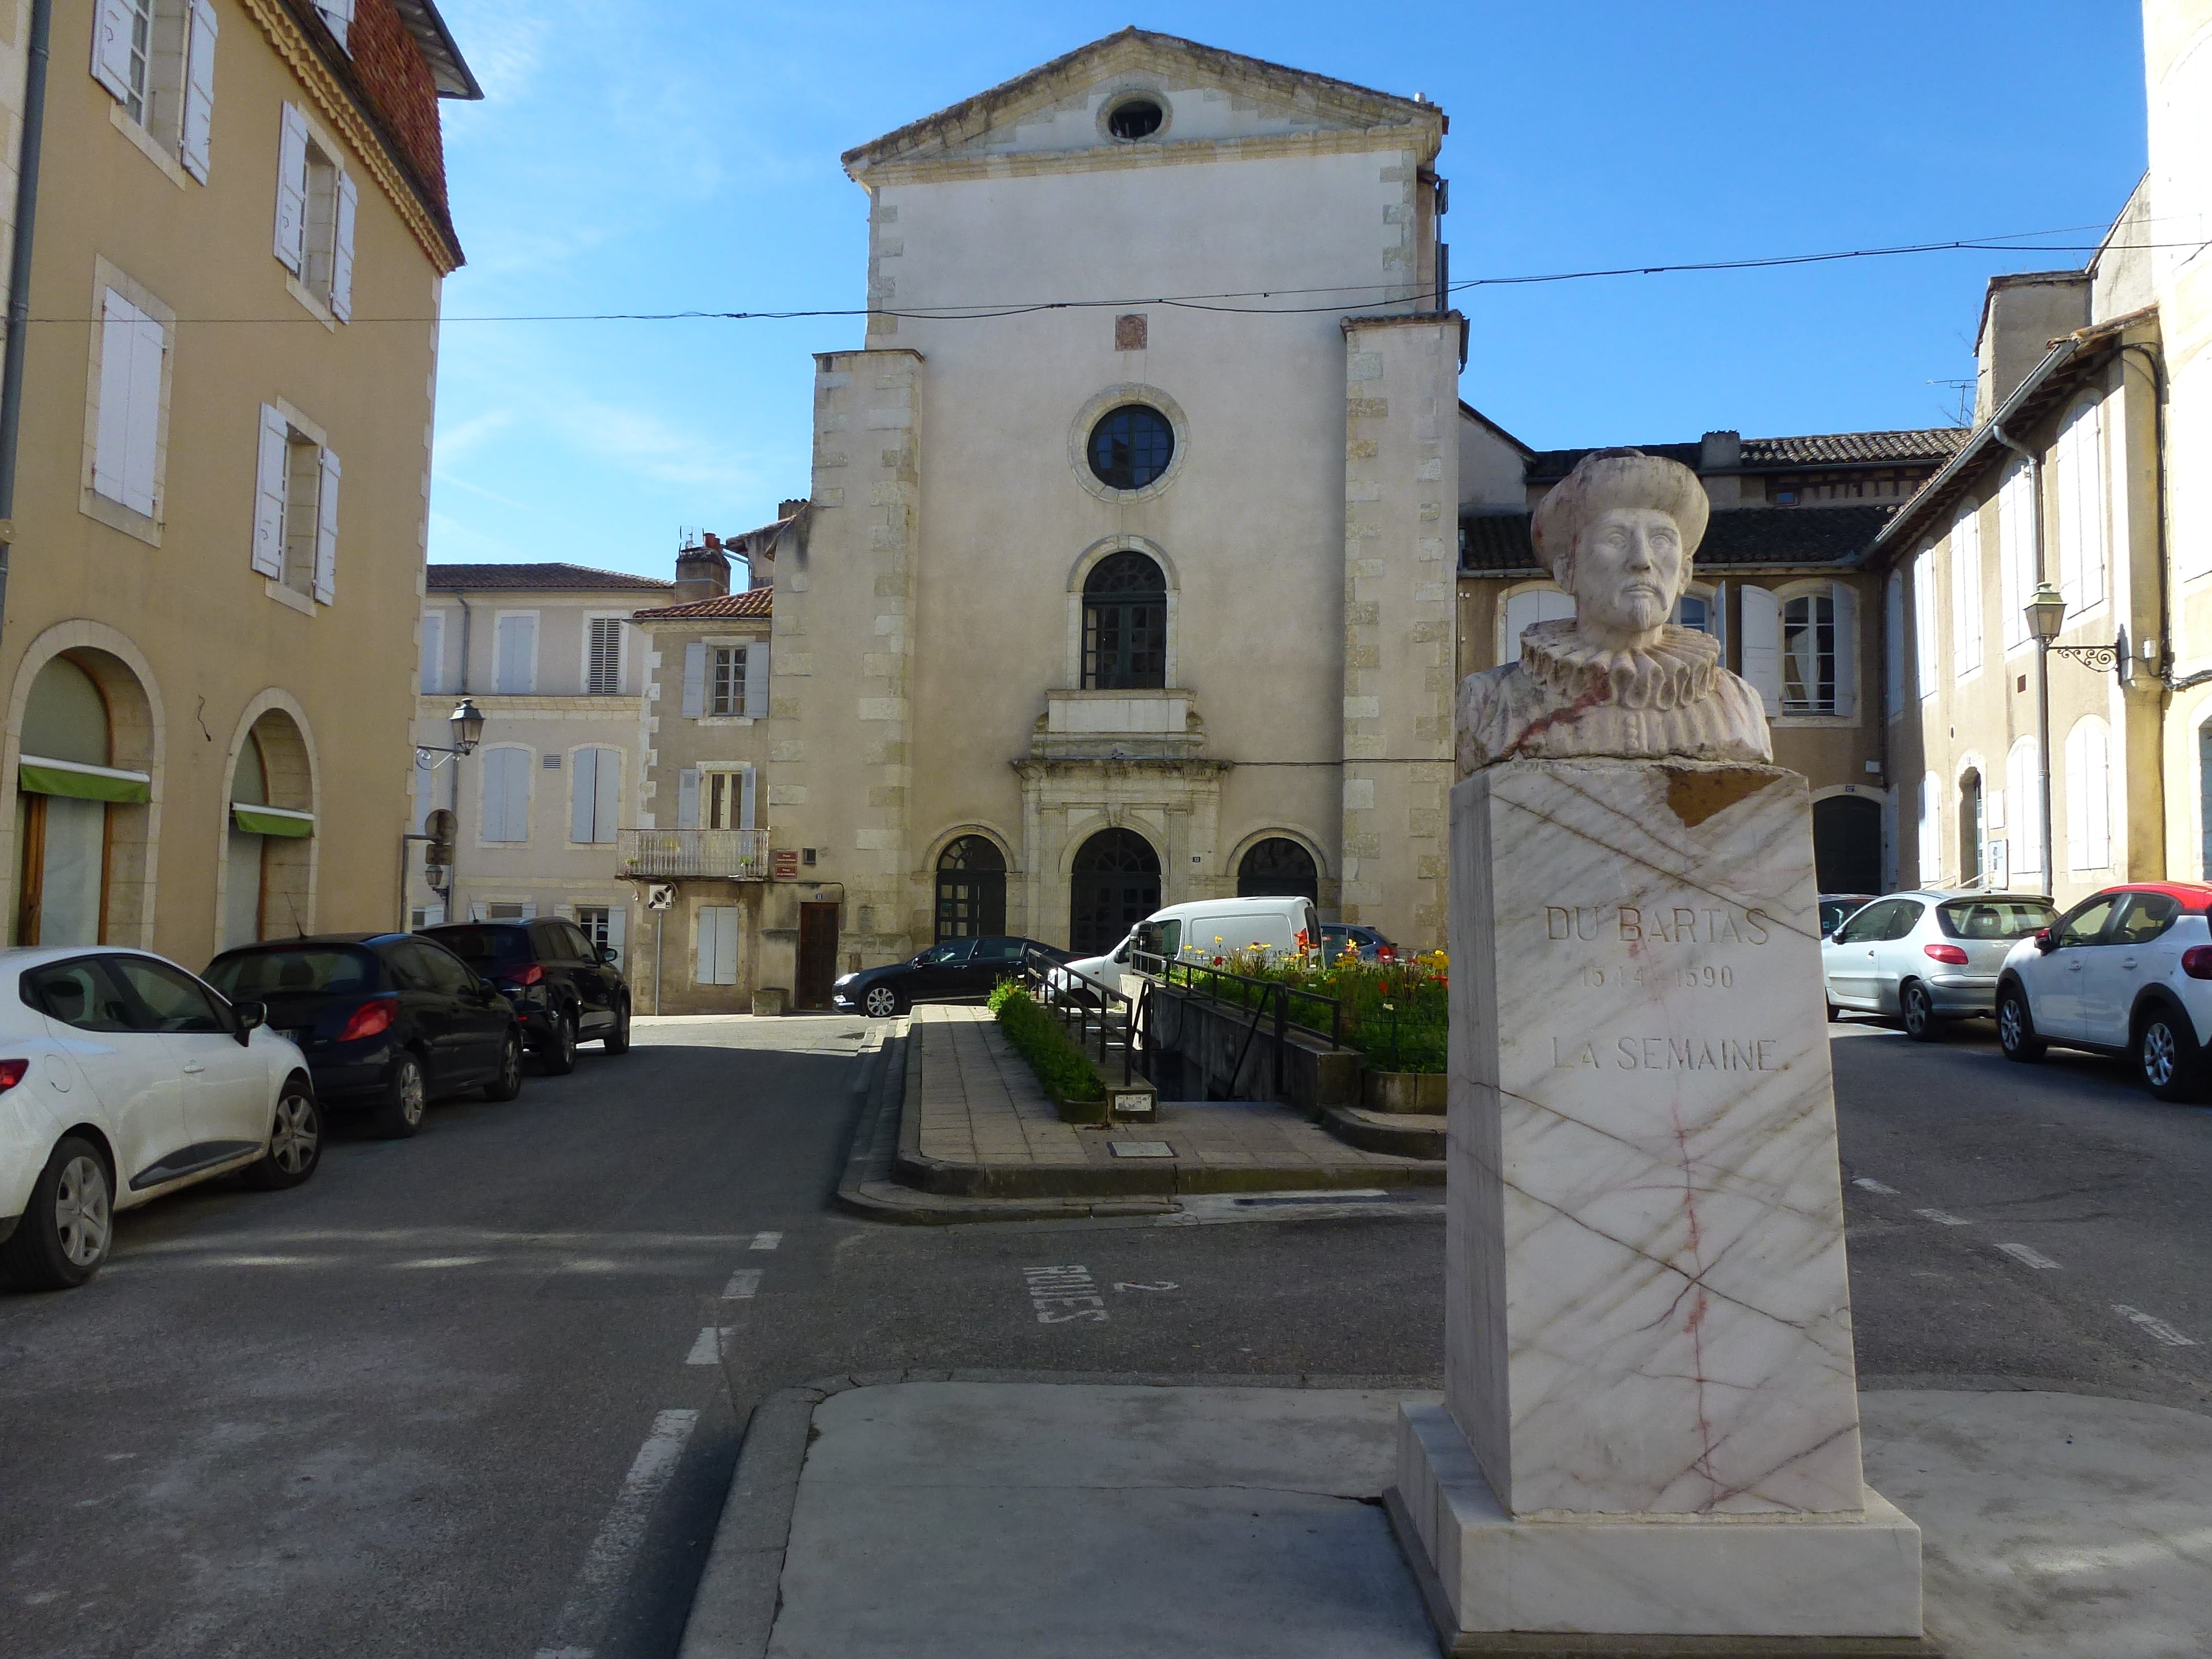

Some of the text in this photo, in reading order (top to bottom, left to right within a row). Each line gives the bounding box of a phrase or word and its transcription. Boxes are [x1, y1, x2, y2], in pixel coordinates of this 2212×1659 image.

[1545, 906, 1770, 945] DU BARTAS
[1674, 966, 1734, 988] 1590
[1552, 1036, 1777, 1071] LA SEMAINE
[1023, 1265, 1180, 1324] 2 ROUES
